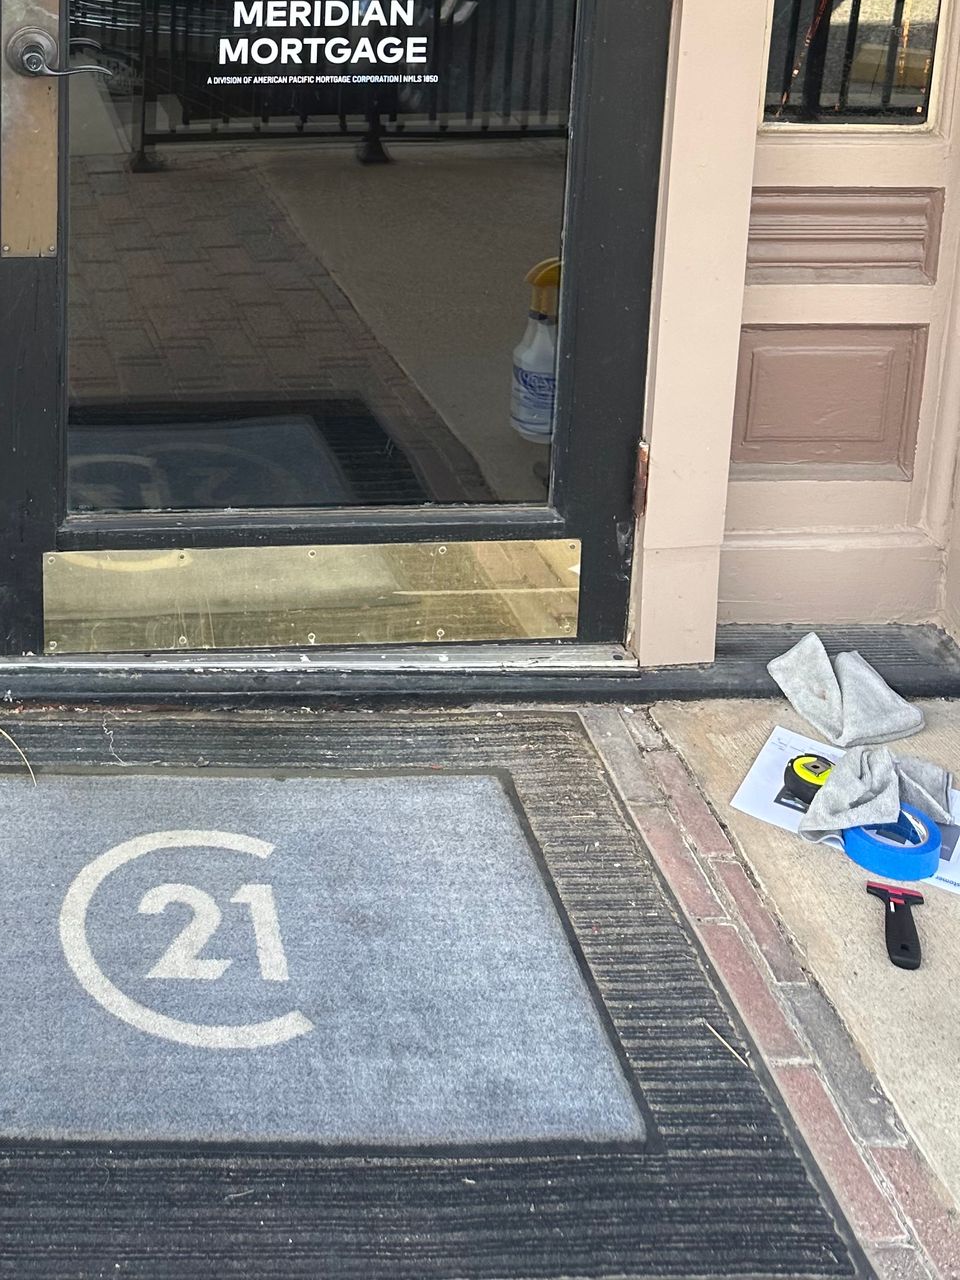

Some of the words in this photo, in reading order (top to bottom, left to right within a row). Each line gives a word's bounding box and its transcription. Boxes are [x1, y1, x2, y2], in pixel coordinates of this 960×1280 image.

[233, 0, 415, 28] MERIDIAN
[218, 36, 428, 65] MORTGAGE
[207, 76, 213, 84] A
[213, 76, 242, 84] DIVISION
[243, 76, 253, 84] OF
[253, 76, 288, 84] AMERICAN
[289, 76, 315, 84] PACIFIC
[316, 75, 351, 83] MORTGAGE
[352, 75, 399, 83] CORPORATION
[403, 74, 422, 83] NMLS
